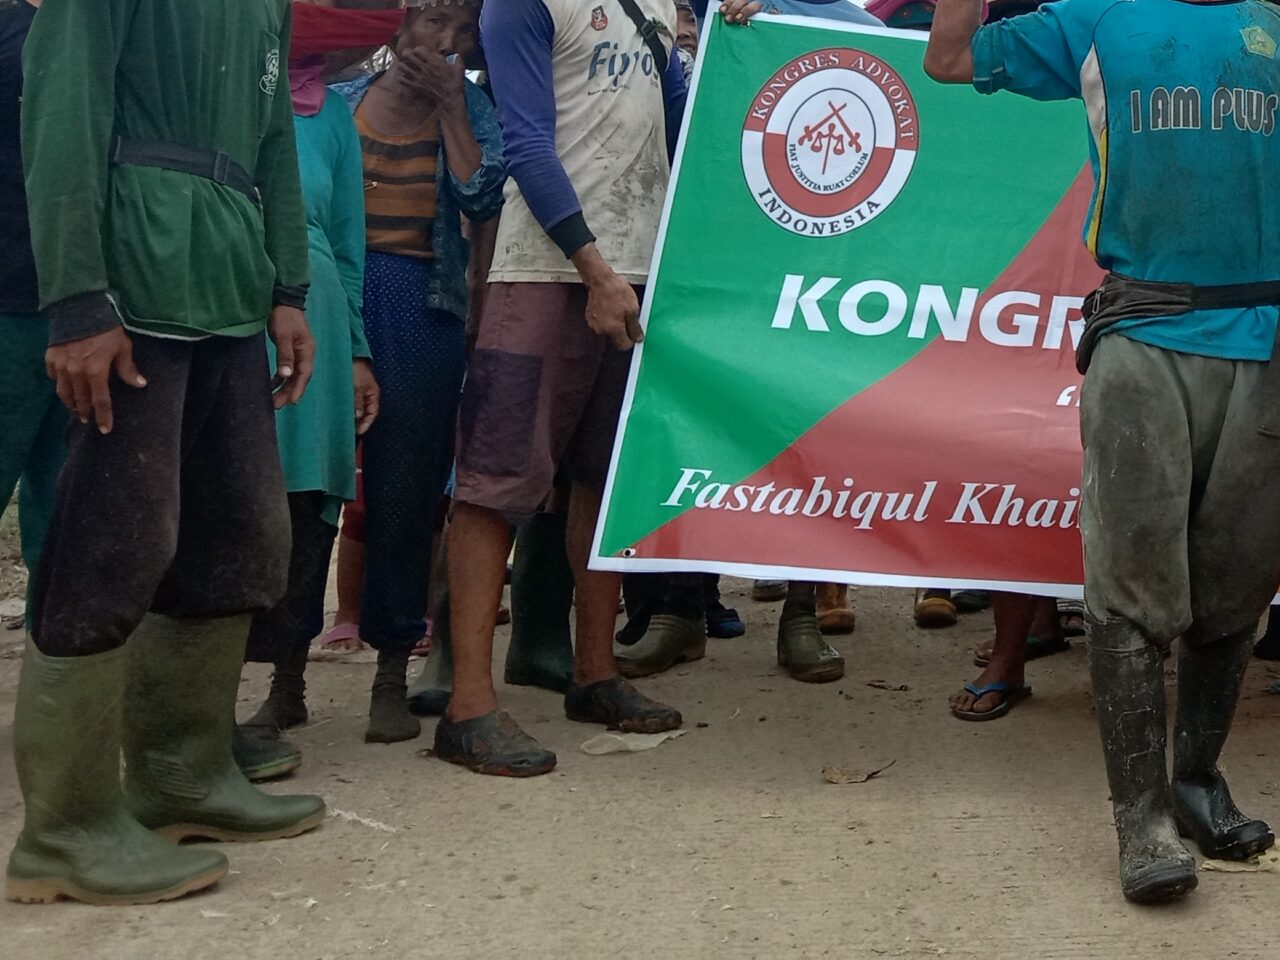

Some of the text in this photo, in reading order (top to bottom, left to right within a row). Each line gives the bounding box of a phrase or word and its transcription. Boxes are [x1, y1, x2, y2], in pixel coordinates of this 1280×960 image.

[752, 53, 915, 141] KONGRES ADVOKAT
[1130, 86, 1279, 136] I AM PLUS
[789, 143, 869, 192] FIAT JUSTITIA RUAT COELUM
[758, 187, 881, 235] INDONESIA
[660, 467, 1081, 530] Fastabiqul Khai
